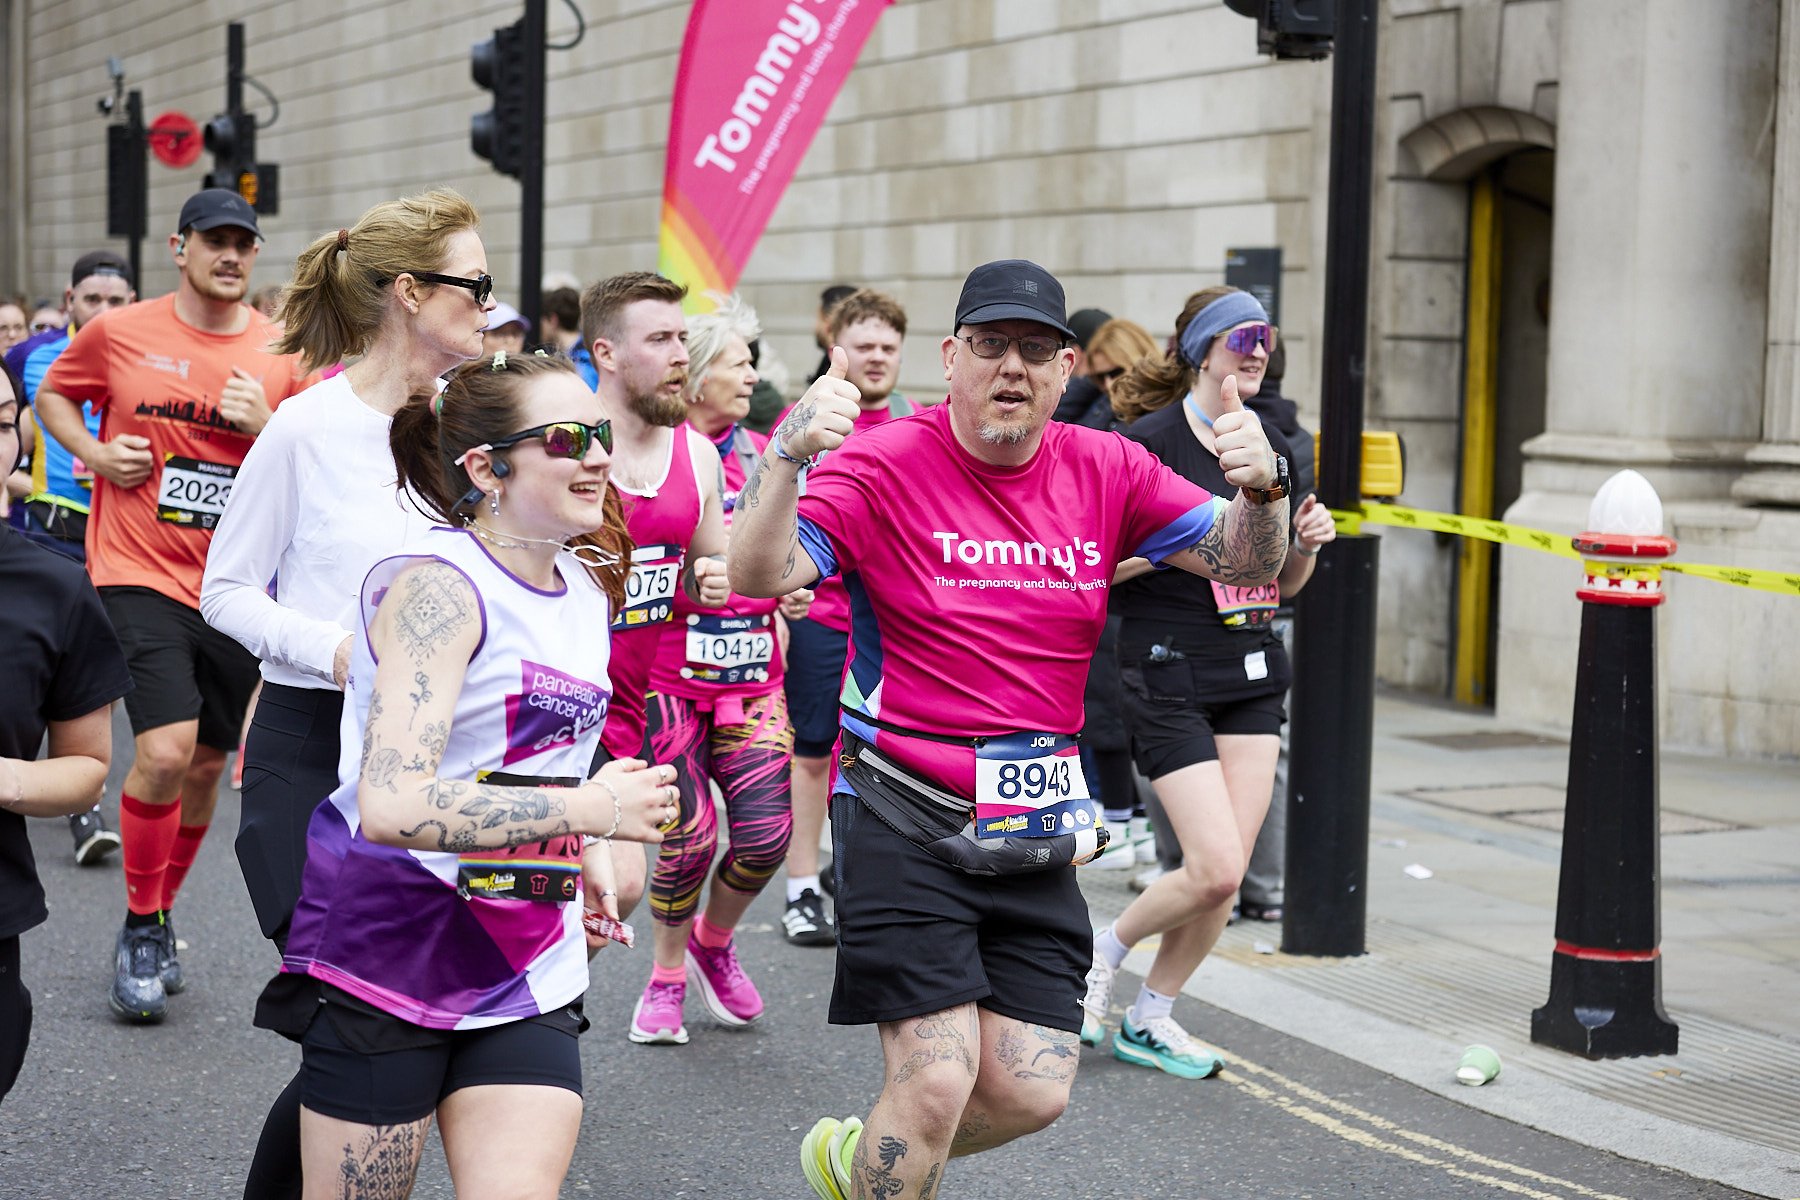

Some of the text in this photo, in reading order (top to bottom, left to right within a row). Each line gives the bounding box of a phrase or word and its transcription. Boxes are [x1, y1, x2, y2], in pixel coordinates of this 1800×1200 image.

[754, 100, 801, 173] pregnancy
[791, 71, 814, 104] and
[804, 40, 835, 77] baby
[934, 576, 956, 588] The
[958, 578, 1021, 591] pregnancy
[1023, 577, 1046, 590] and
[1047, 577, 1077, 592] baby
[697, 637, 768, 661] 10412
[528, 691, 580, 719] cancer
[532, 671, 598, 707] pancreatic
[533, 697, 608, 751] action
[997, 760, 1071, 799] 8943
